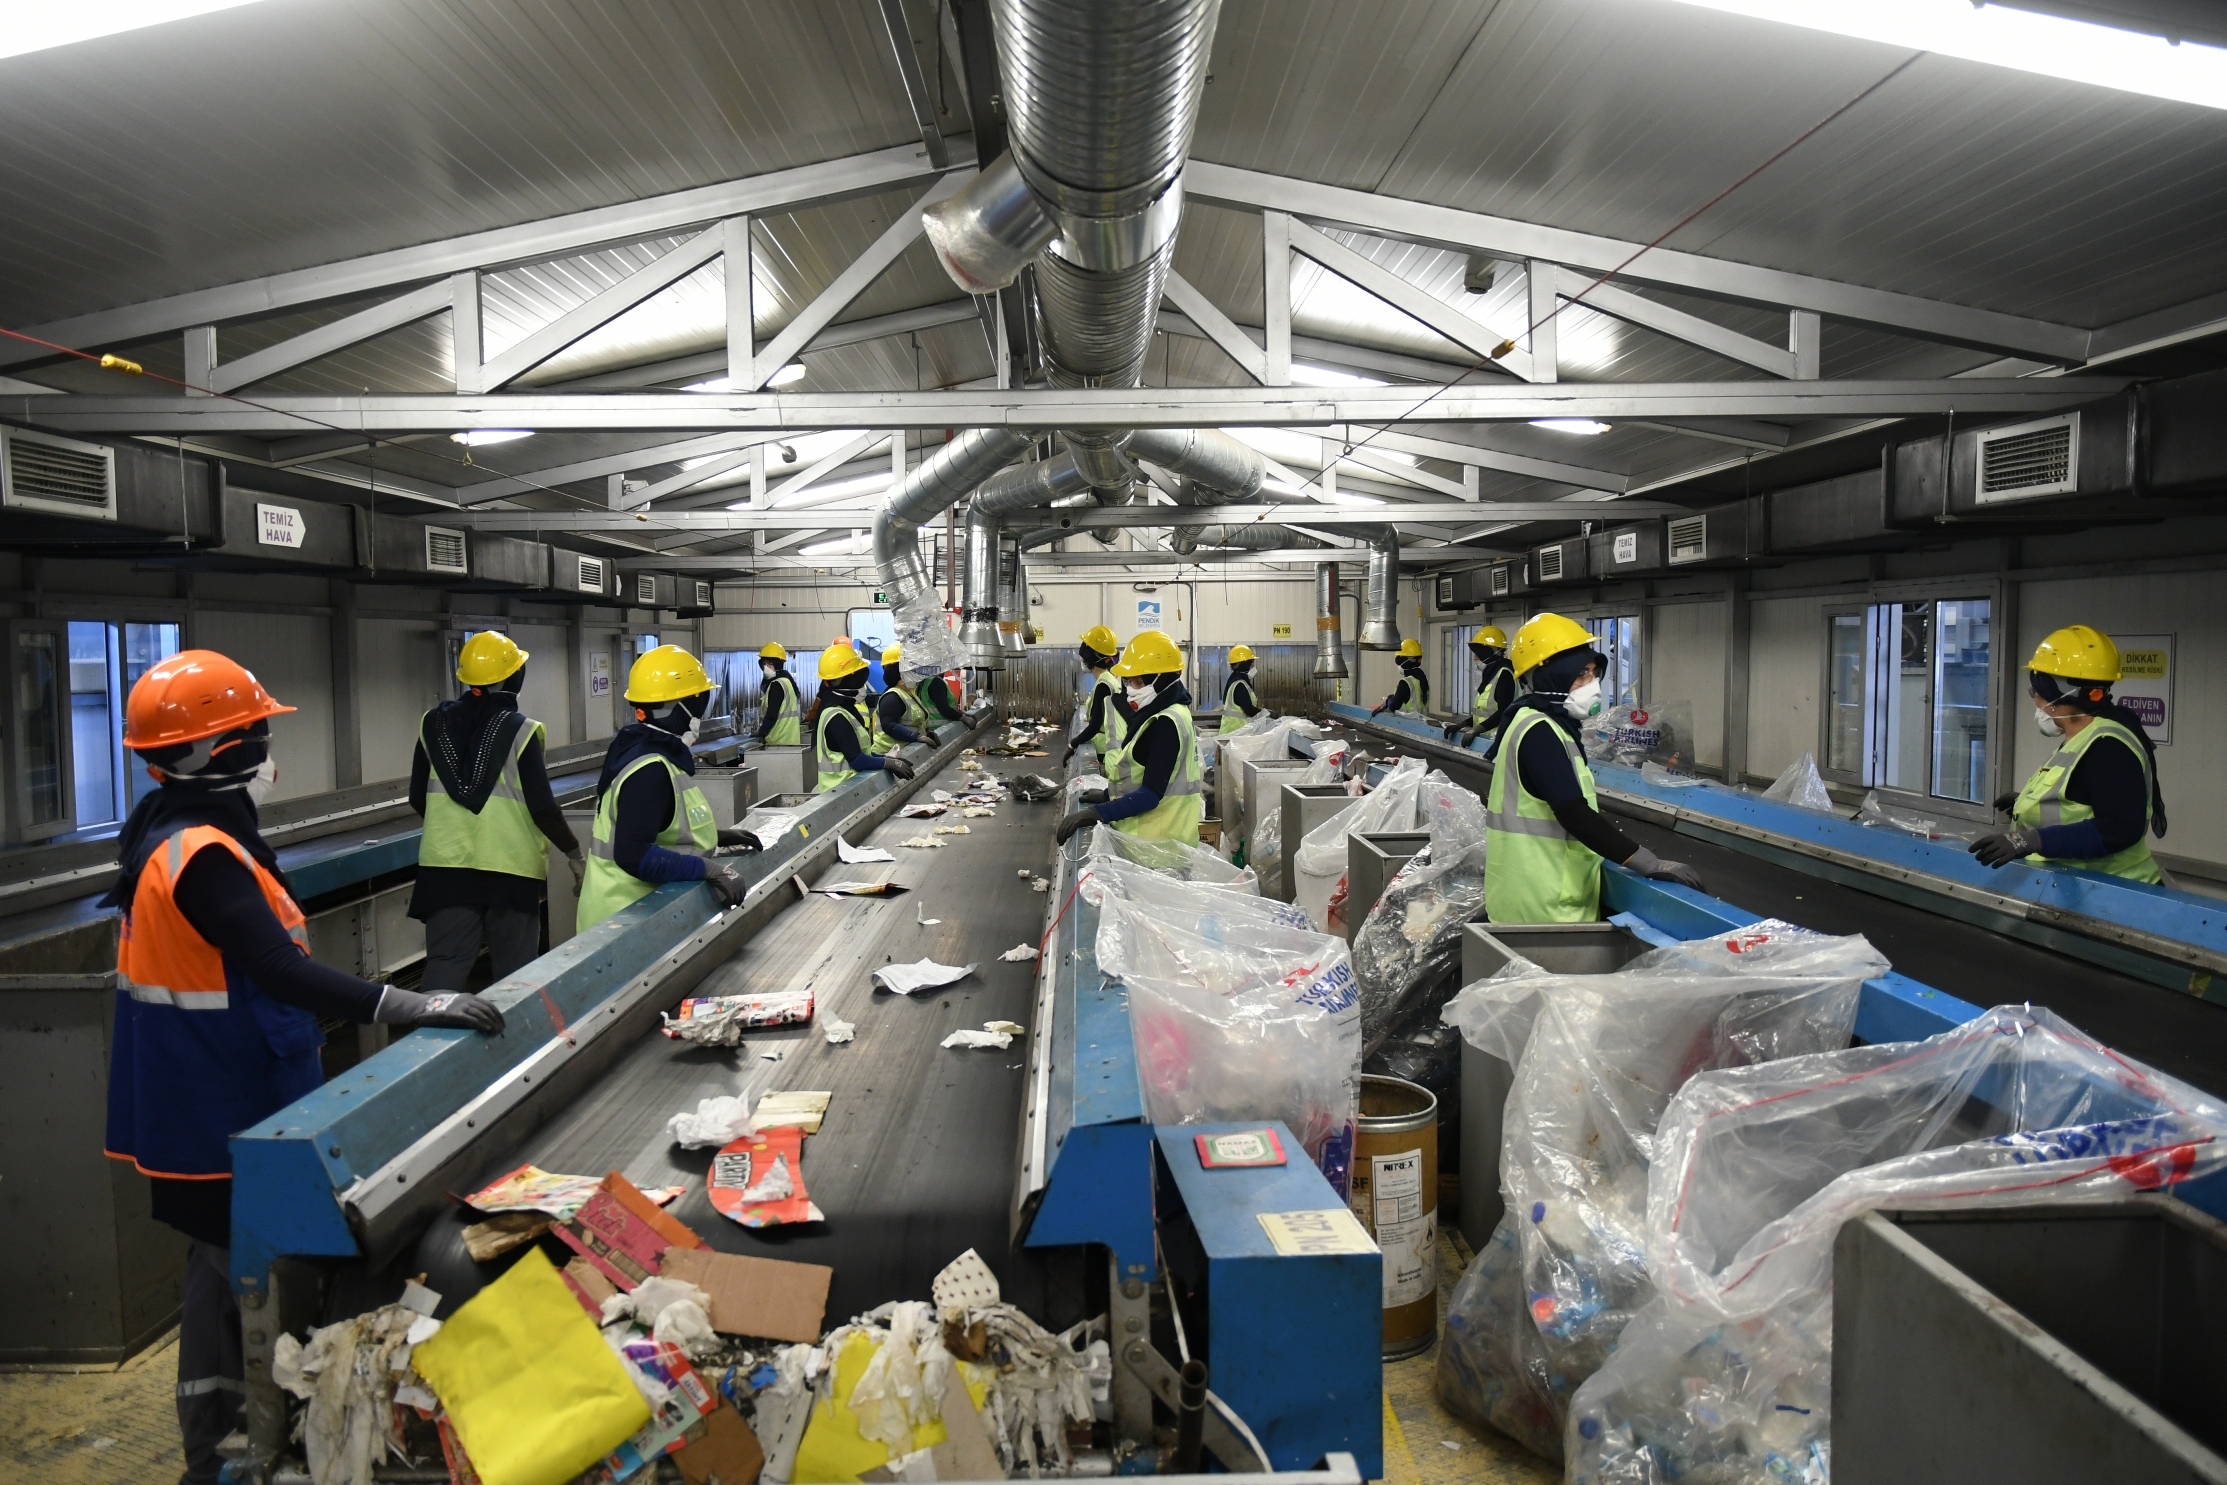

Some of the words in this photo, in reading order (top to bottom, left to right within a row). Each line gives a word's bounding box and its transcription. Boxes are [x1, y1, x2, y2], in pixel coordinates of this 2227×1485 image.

[263, 510, 294, 527] TEMİZ
[266, 528, 293, 543] HAVA
[1618, 536, 1633, 548] TEMİZ
[1618, 549, 1632, 559] HAVA
[2126, 652, 2158, 664] DİKKAT
[2146, 666, 2163, 674] RİSKİ
[2122, 698, 2160, 710] ELDİVEN
[1615, 727, 1660, 738] TURKISH
[1613, 735, 1660, 746] AIRLINES
[1295, 961, 1353, 1005] TURKISH
[715, 1152, 750, 1190] PARTY
[1383, 1160, 1414, 1172] NITREX
